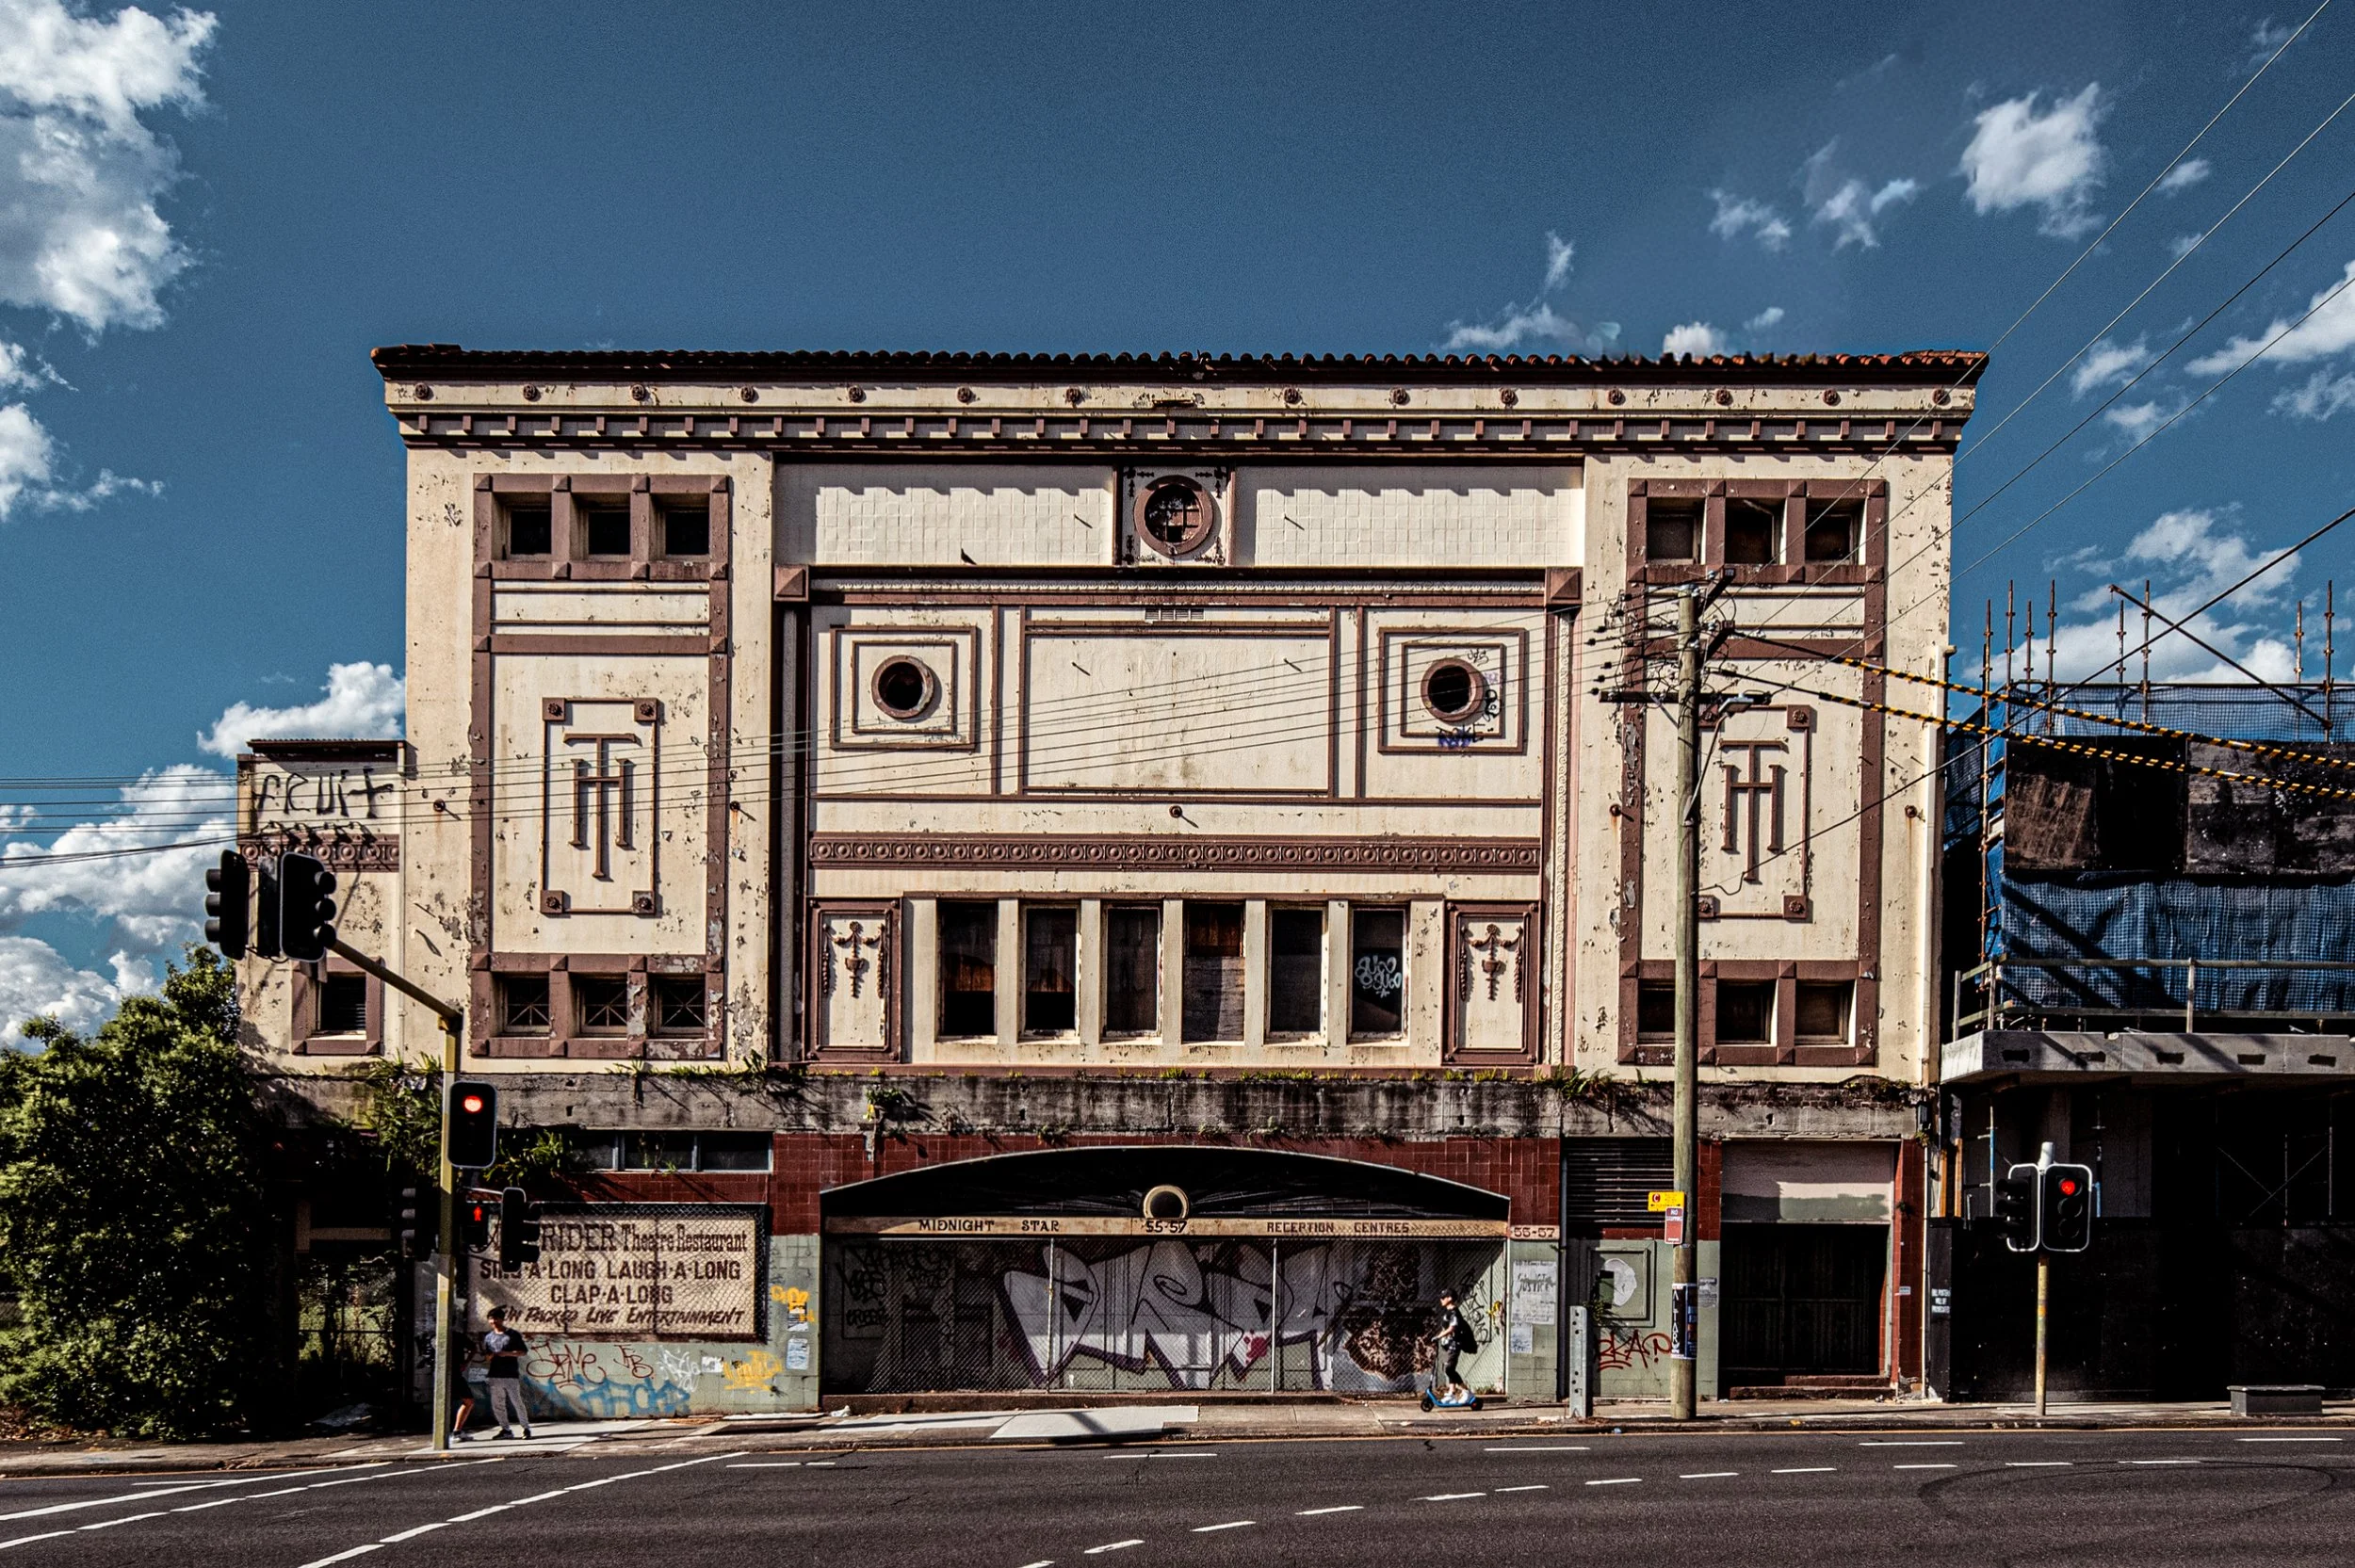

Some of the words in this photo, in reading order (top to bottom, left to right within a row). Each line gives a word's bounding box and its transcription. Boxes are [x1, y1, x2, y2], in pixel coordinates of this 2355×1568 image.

[918, 1220, 995, 1232] MIDNIGHT
[1021, 1220, 1060, 1232] STAR
[1267, 1222, 1334, 1233] RECEPTION
[1354, 1222, 1410, 1233] CENTRES
[622, 1223, 674, 1252] Theatre
[676, 1223, 748, 1252] Restaurant
[626, 1306, 745, 1326] ENTERTAINMENT
